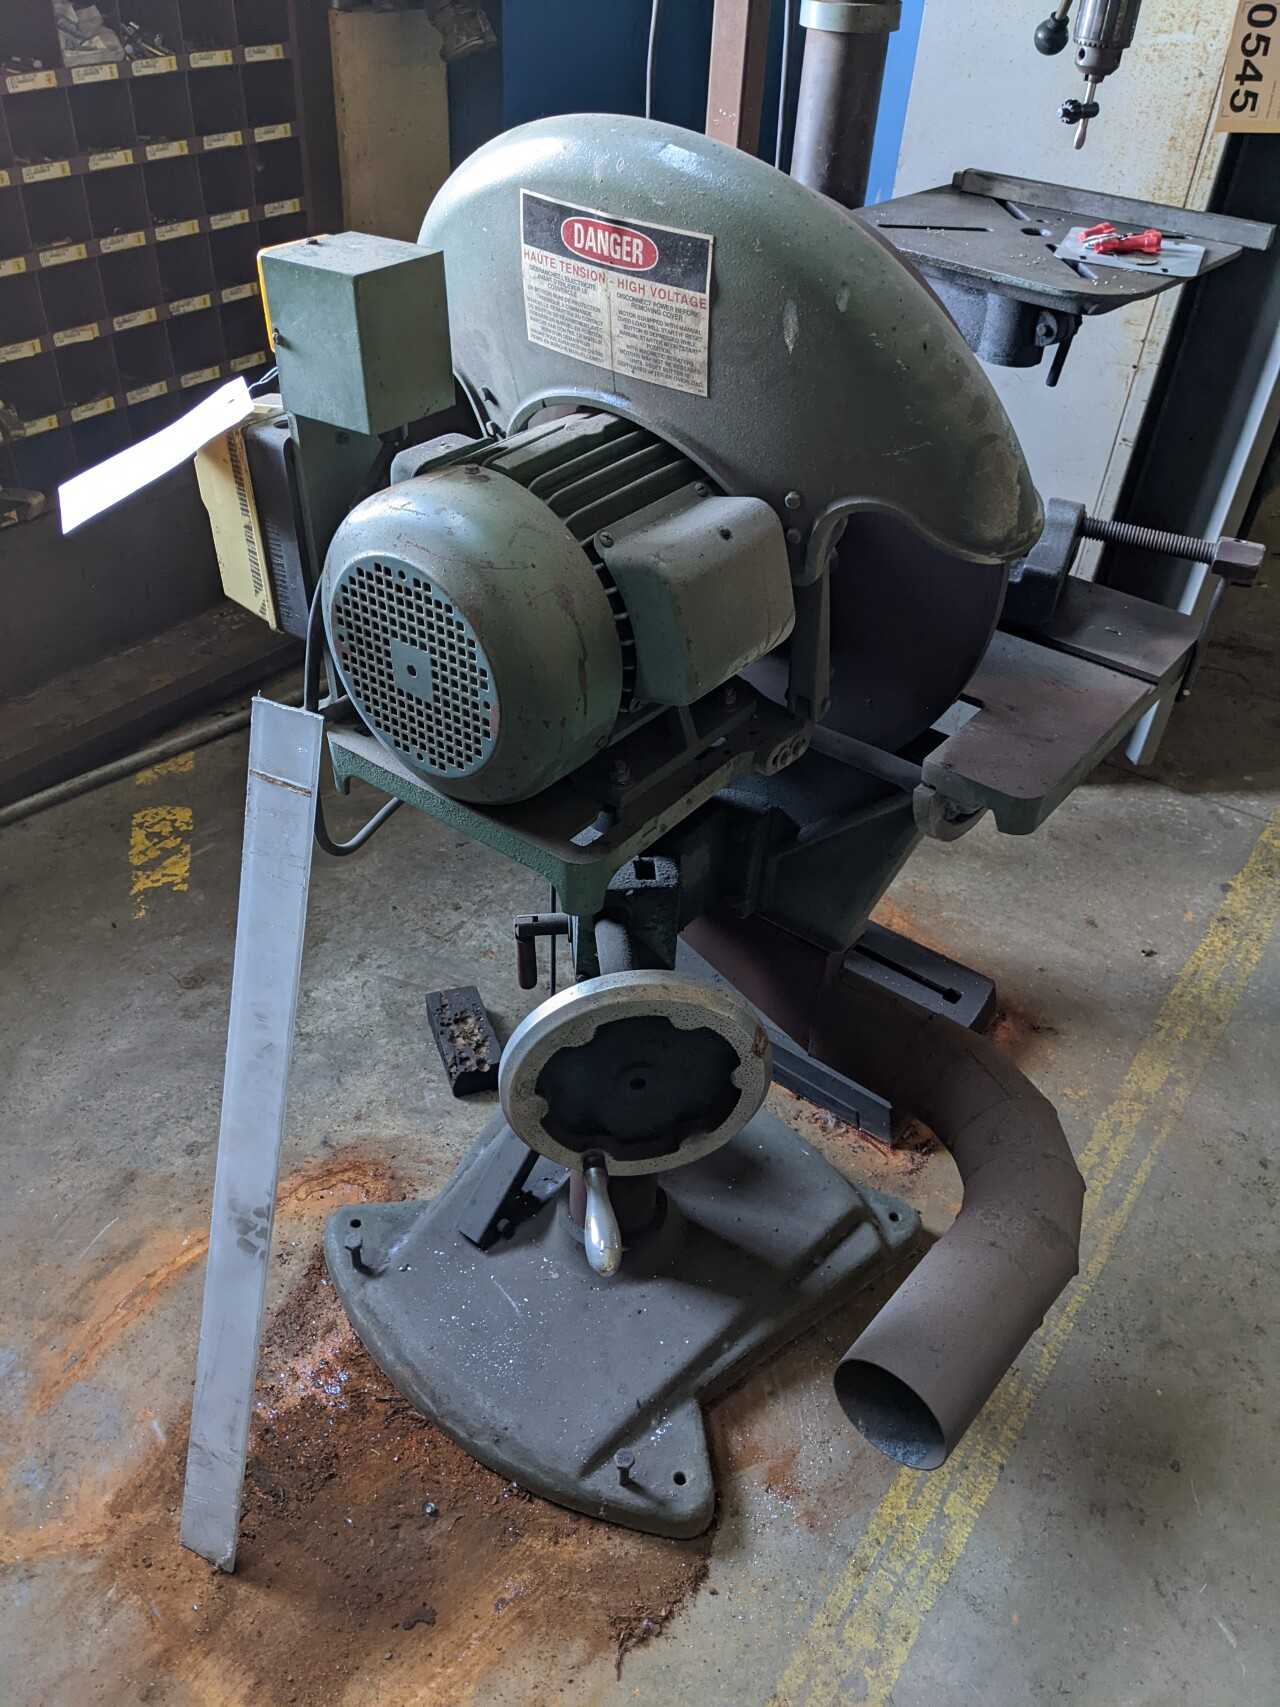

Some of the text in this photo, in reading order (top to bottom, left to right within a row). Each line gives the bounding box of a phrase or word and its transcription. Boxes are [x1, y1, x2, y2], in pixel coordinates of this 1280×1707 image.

[574, 222, 644, 266] DANGER
[523, 249, 557, 270] HAUTE
[560, 260, 606, 284] TENSION
[617, 278, 646, 296] HIGH
[650, 284, 707, 311] VOLTAGE
[662, 310, 682, 321] COVER
